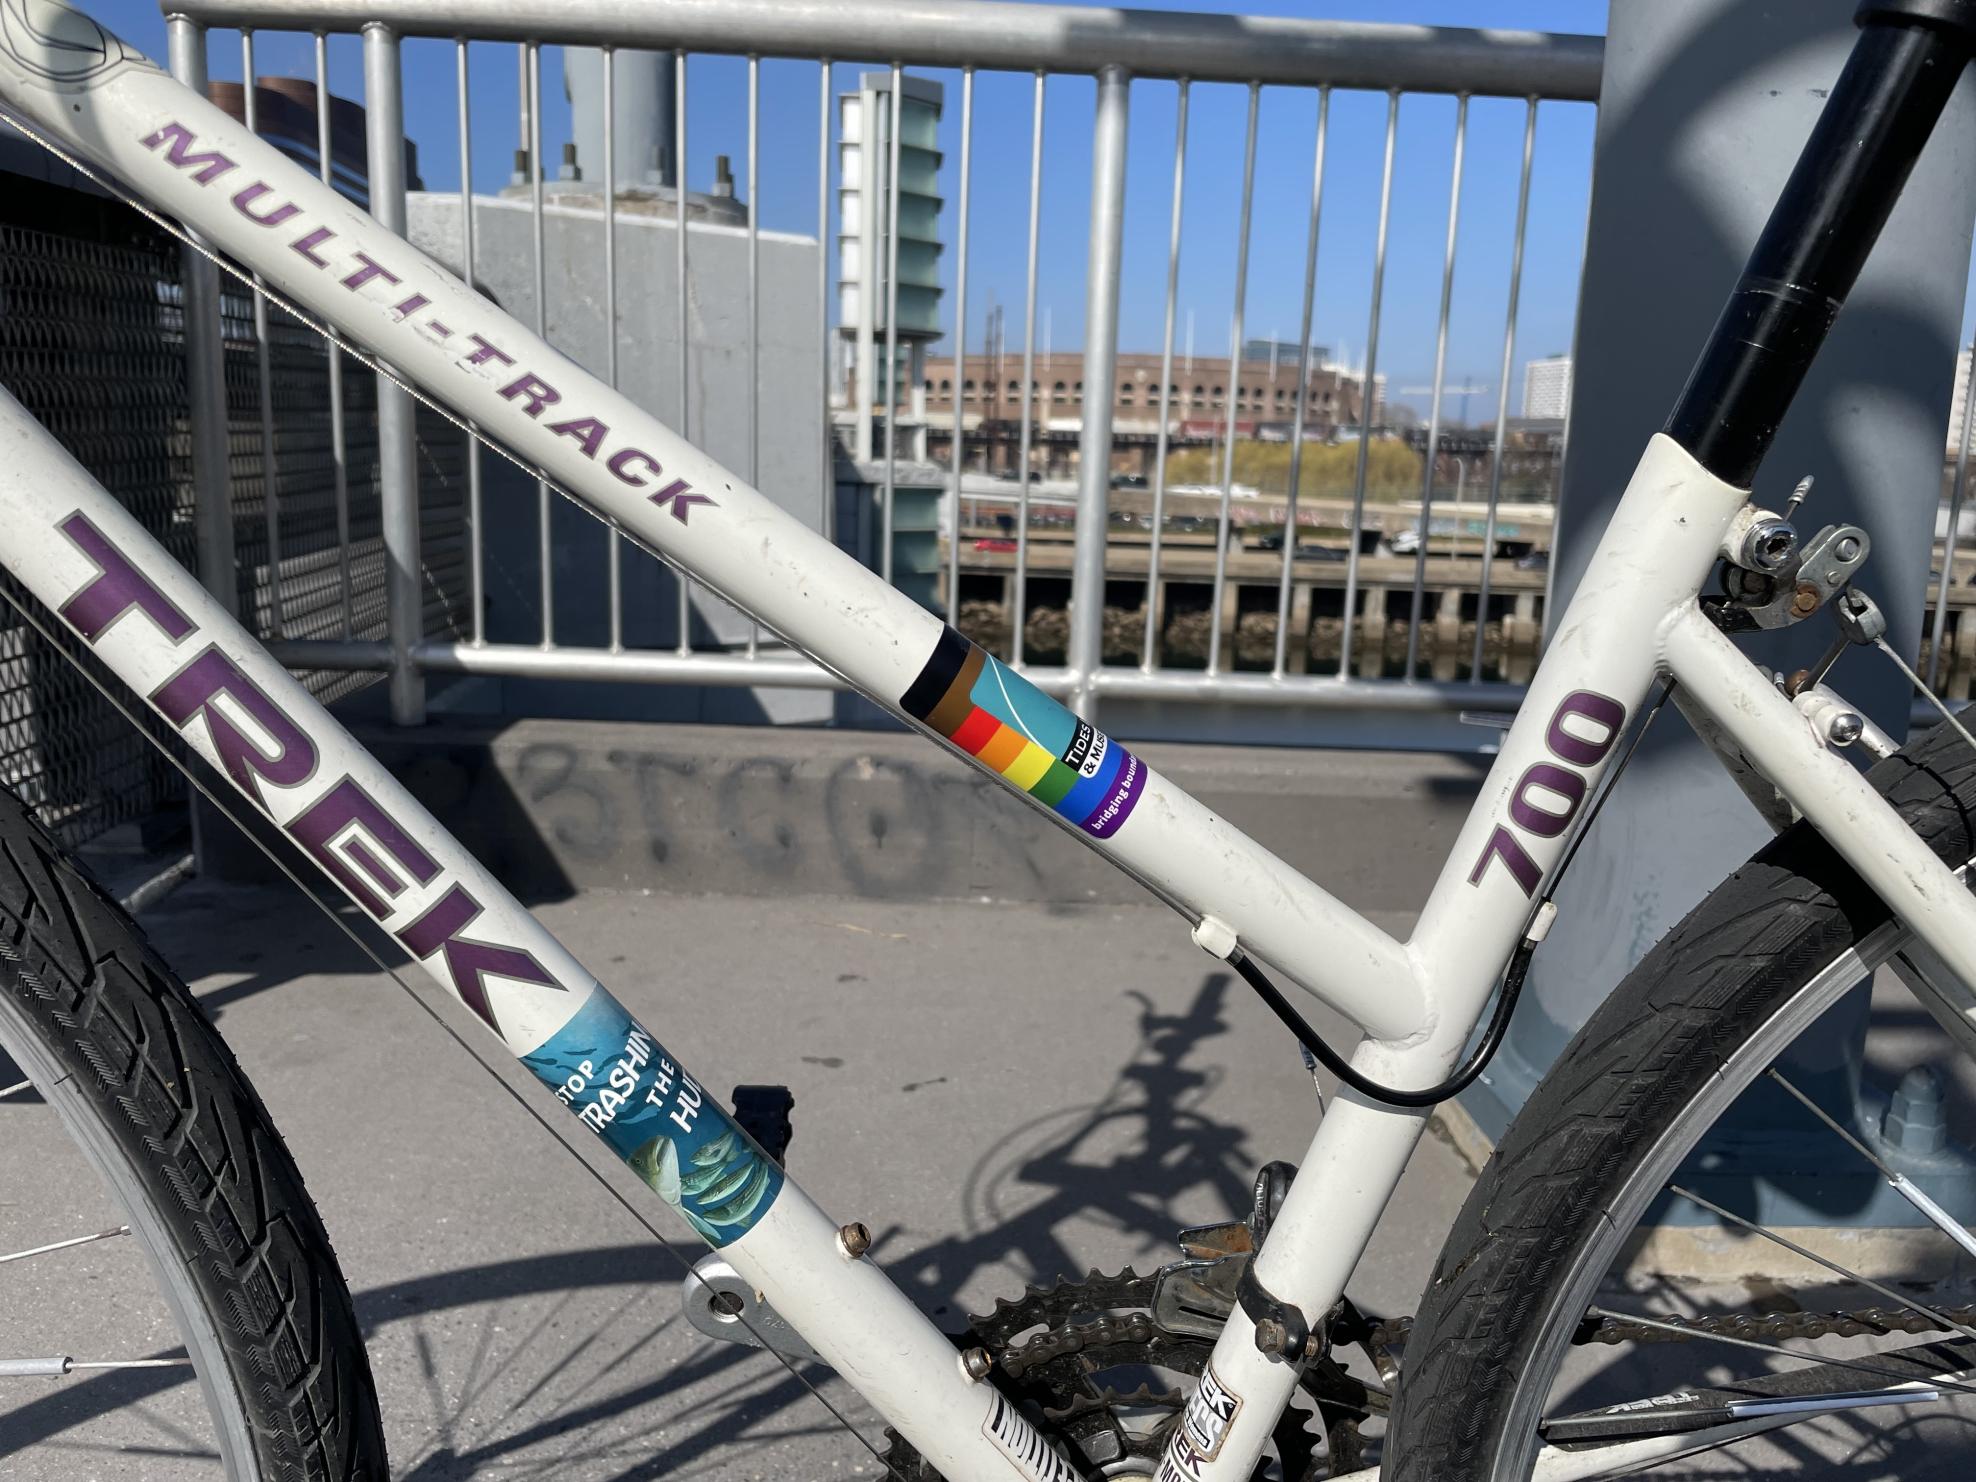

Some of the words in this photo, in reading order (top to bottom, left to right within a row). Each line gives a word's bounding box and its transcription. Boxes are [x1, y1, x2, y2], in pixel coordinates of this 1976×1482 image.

[140, 121, 721, 527] MULTI-TRACK
[1064, 723, 1091, 764] TIDES
[1083, 762, 1096, 775] &
[53, 508, 570, 1046] TREK
[1466, 688, 1626, 901] 700
[1091, 788, 1129, 830] bridging
[645, 1057, 675, 1107] THE
